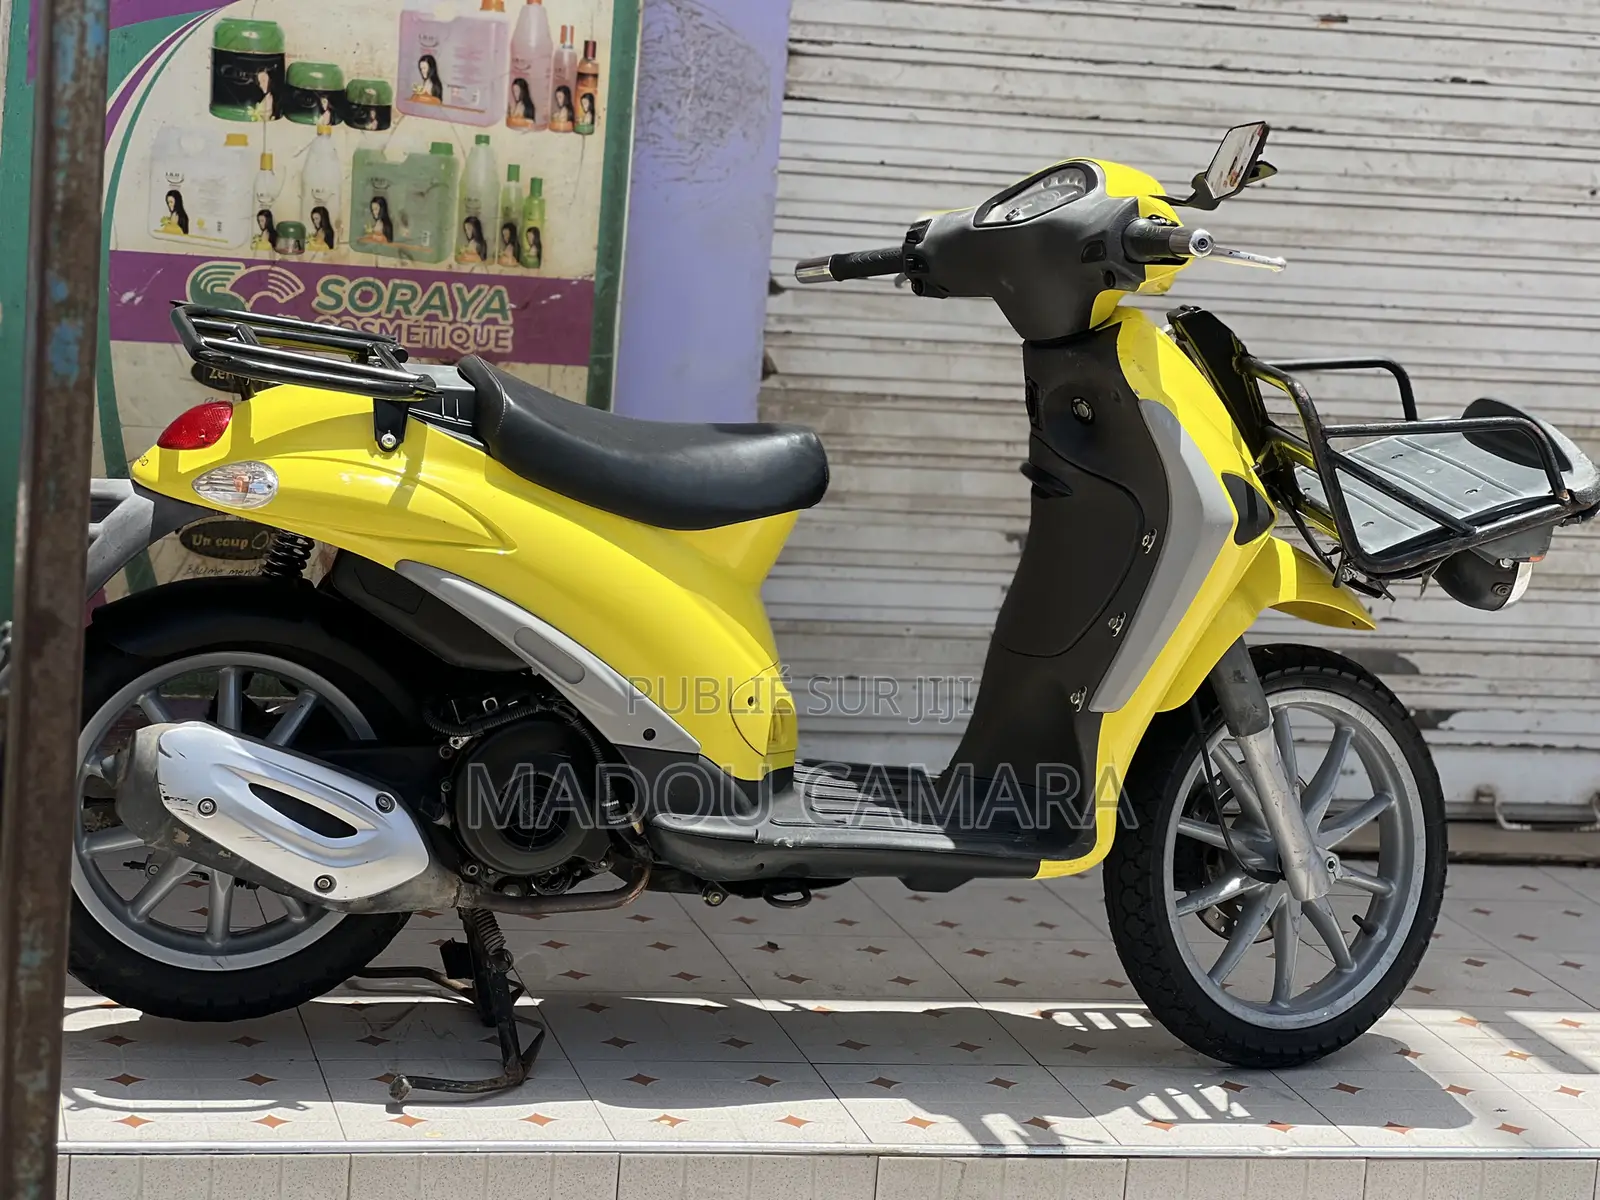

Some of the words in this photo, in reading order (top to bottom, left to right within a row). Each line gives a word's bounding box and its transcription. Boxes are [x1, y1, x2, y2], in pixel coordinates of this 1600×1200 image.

[313, 276, 513, 324] SORAYA
[317, 316, 513, 353] SMÉTIQUE
[191, 534, 212, 547] Un
[215, 537, 249, 550] coup
